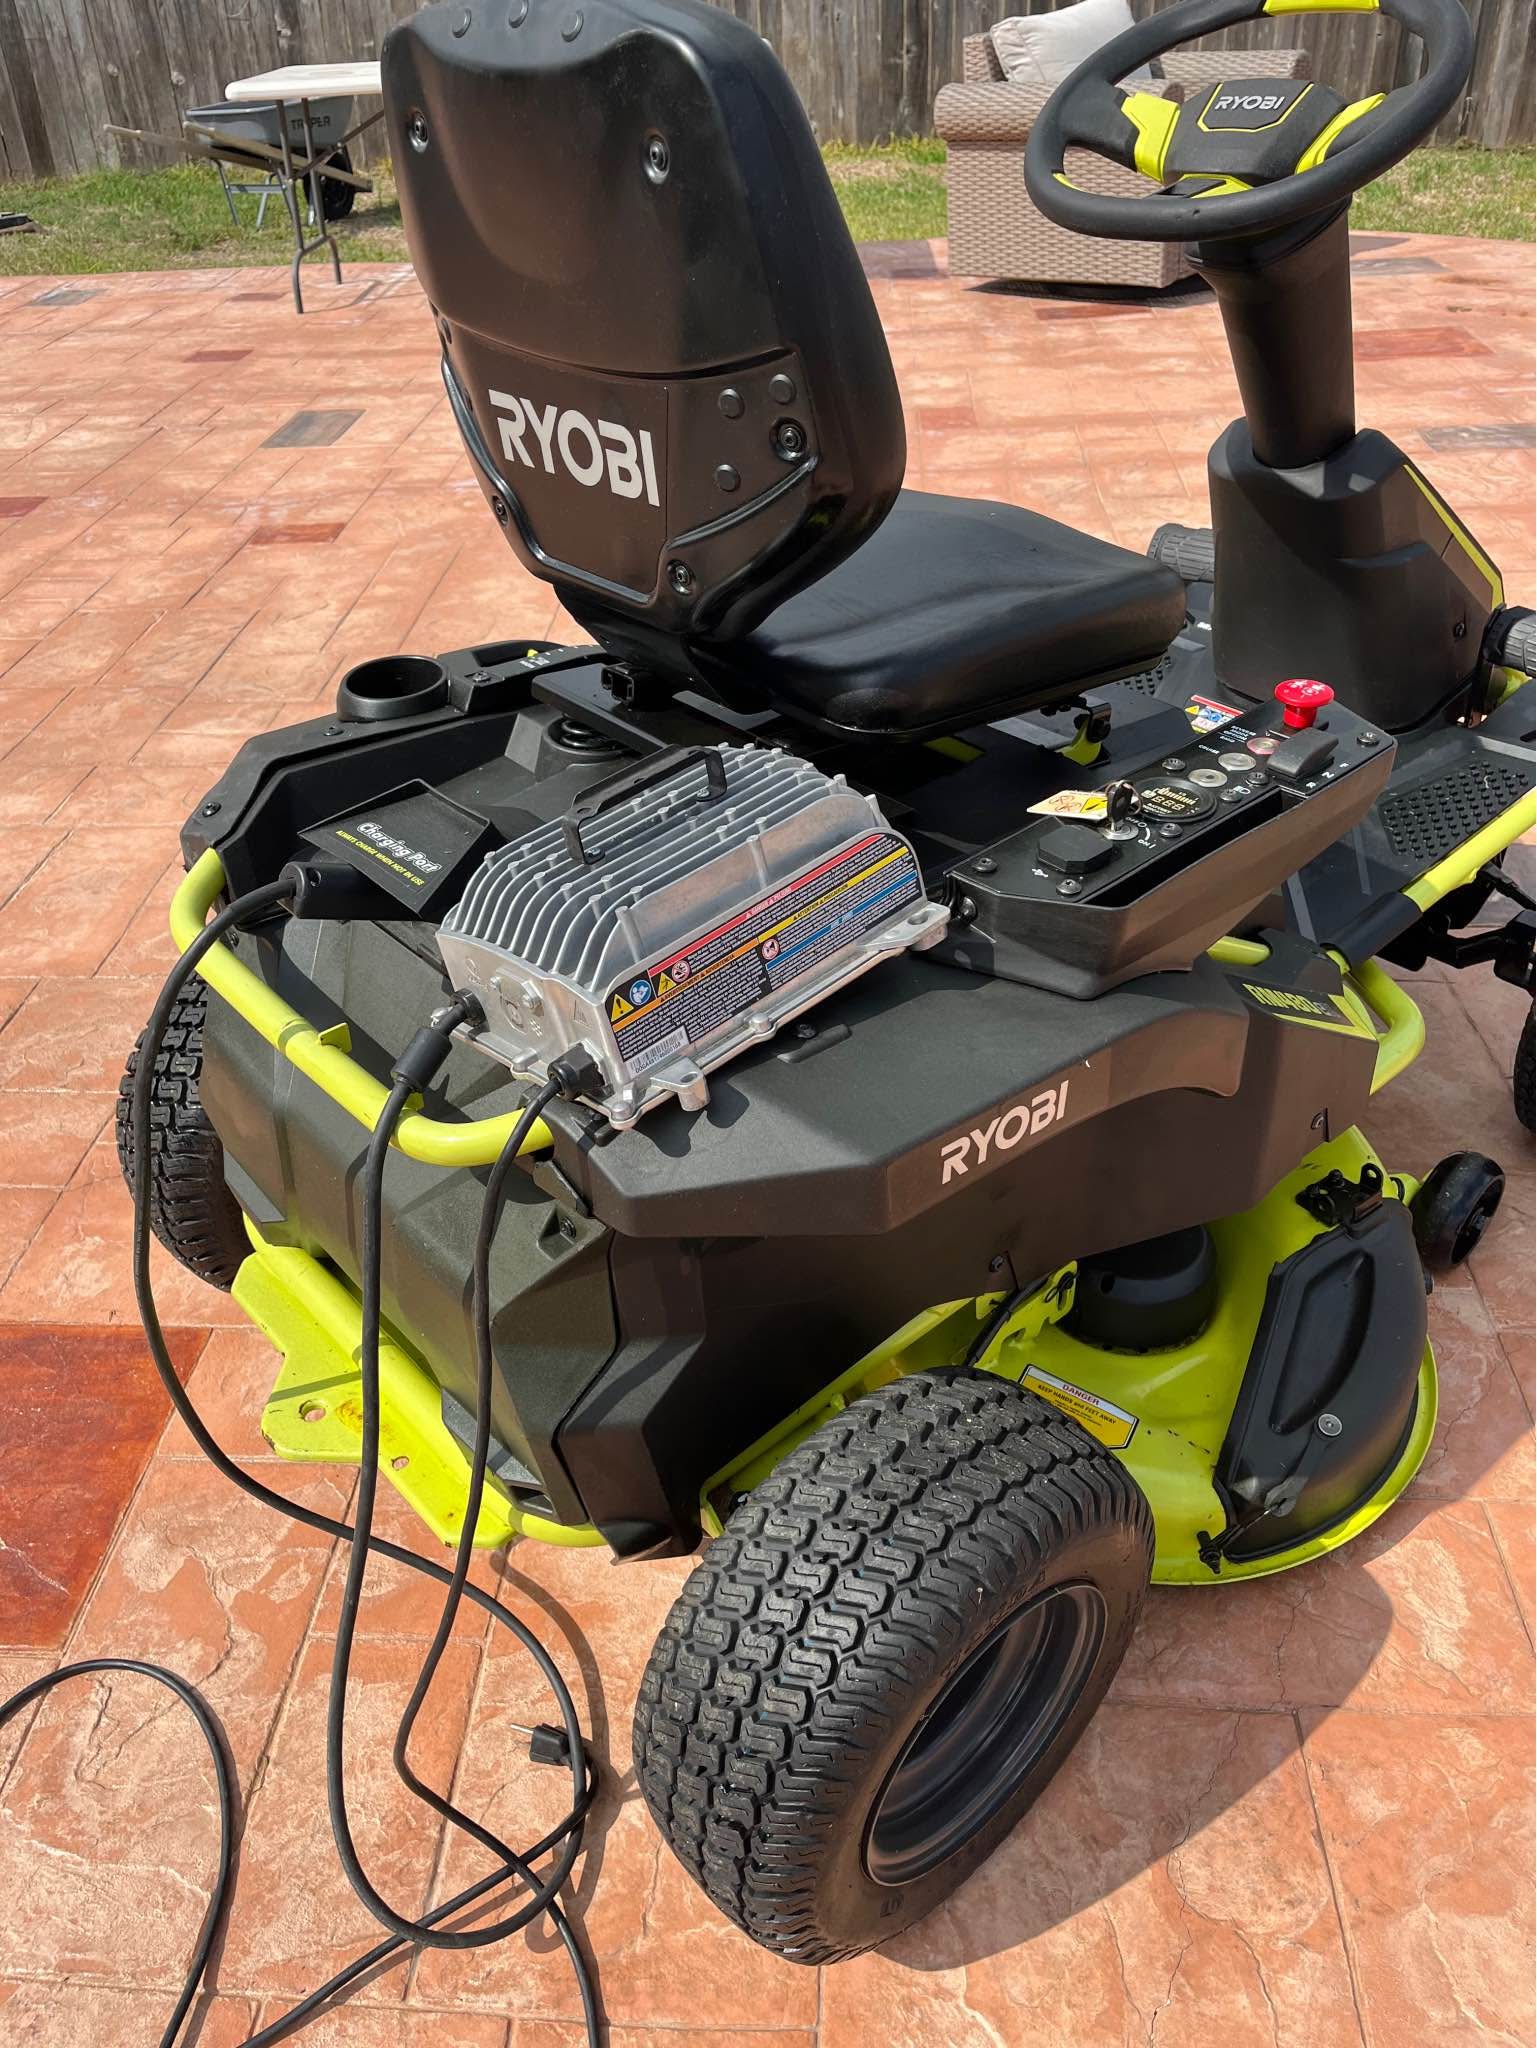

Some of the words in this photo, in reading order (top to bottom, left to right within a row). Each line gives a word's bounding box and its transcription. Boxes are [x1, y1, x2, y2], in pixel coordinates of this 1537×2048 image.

[291, 116, 331, 130] TRPER
[1214, 95, 1286, 110] RYOBI
[488, 389, 660, 507] RYOBI
[358, 822, 412, 857] Charging
[407, 852, 441, 873] Port
[941, 1079, 1069, 1185] RYOBI
[1037, 1384, 1053, 1395] KEEP
[1053, 1390, 1073, 1404] HANDS
[1085, 1405, 1100, 1416] FEET
[1099, 1413, 1117, 1425] AWAY
[1062, 1384, 1101, 1406] DANGER
